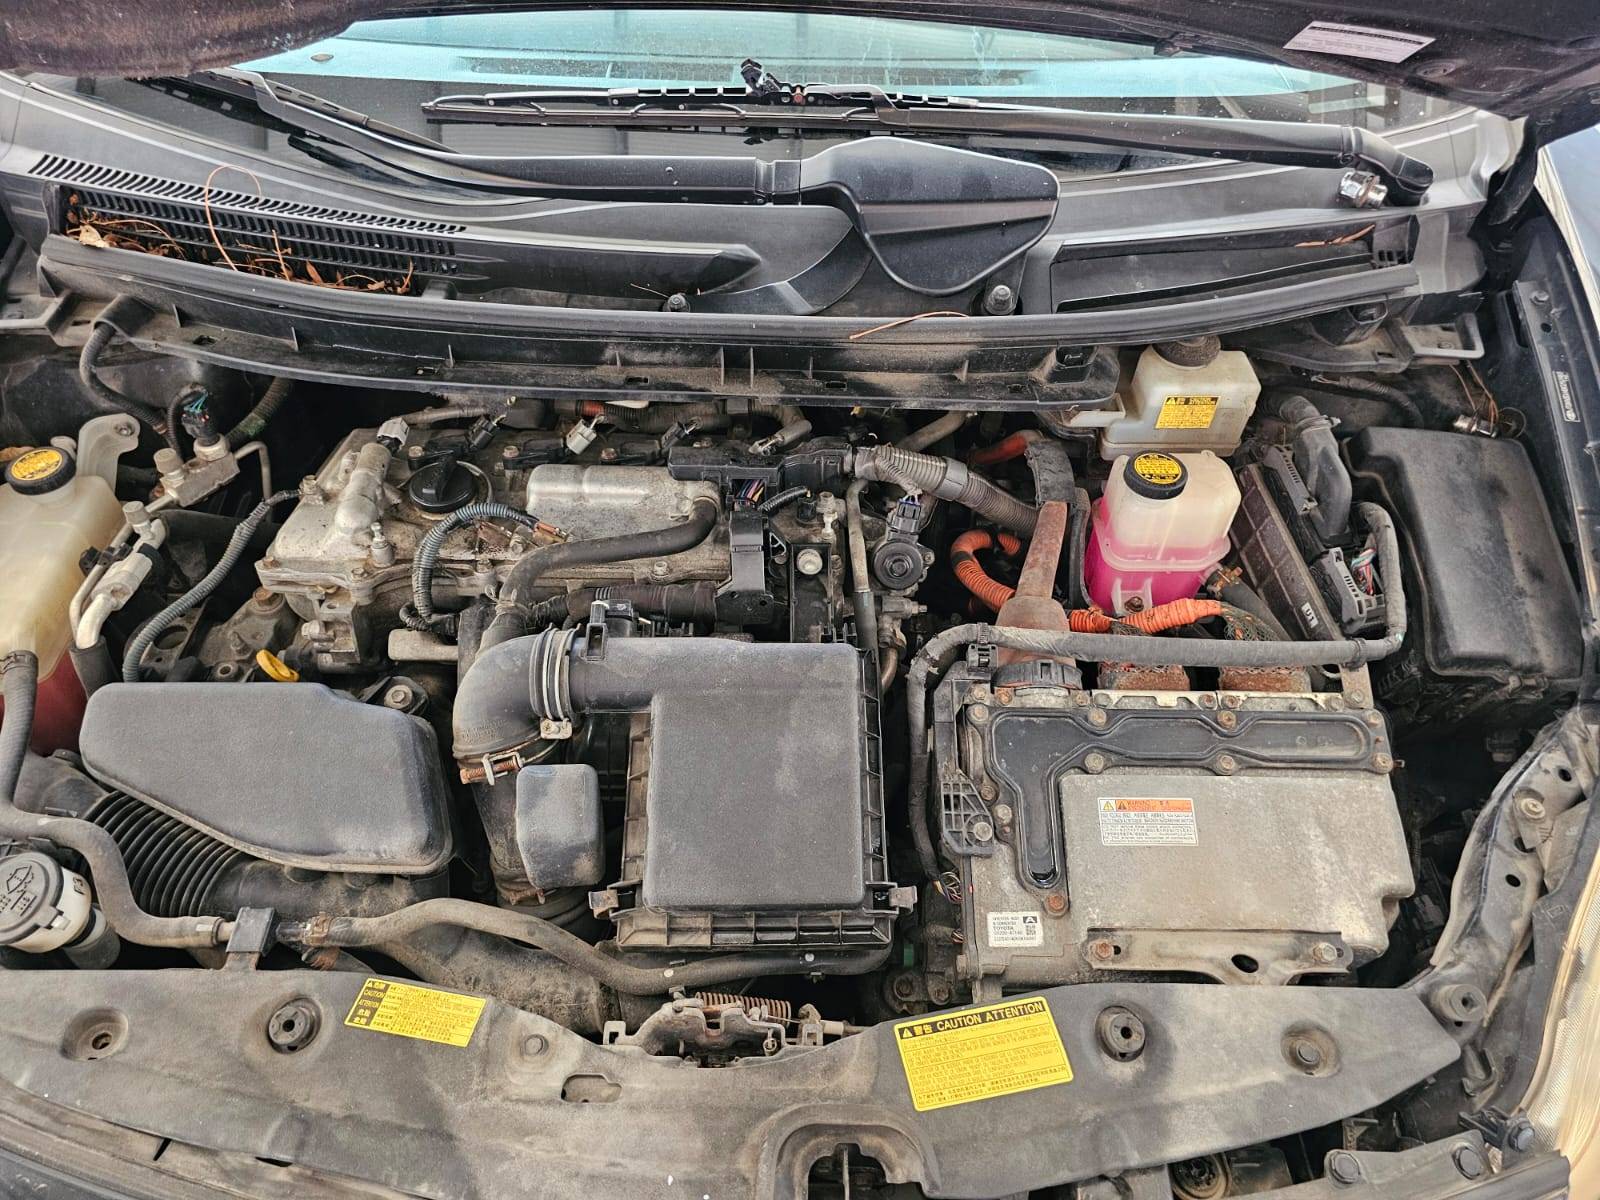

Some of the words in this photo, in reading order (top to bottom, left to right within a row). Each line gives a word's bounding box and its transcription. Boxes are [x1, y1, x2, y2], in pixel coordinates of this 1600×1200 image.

[363, 989, 386, 998] CAUTION
[936, 1014, 982, 1032] CAUTION
[985, 1001, 1044, 1023] ATTENTION
